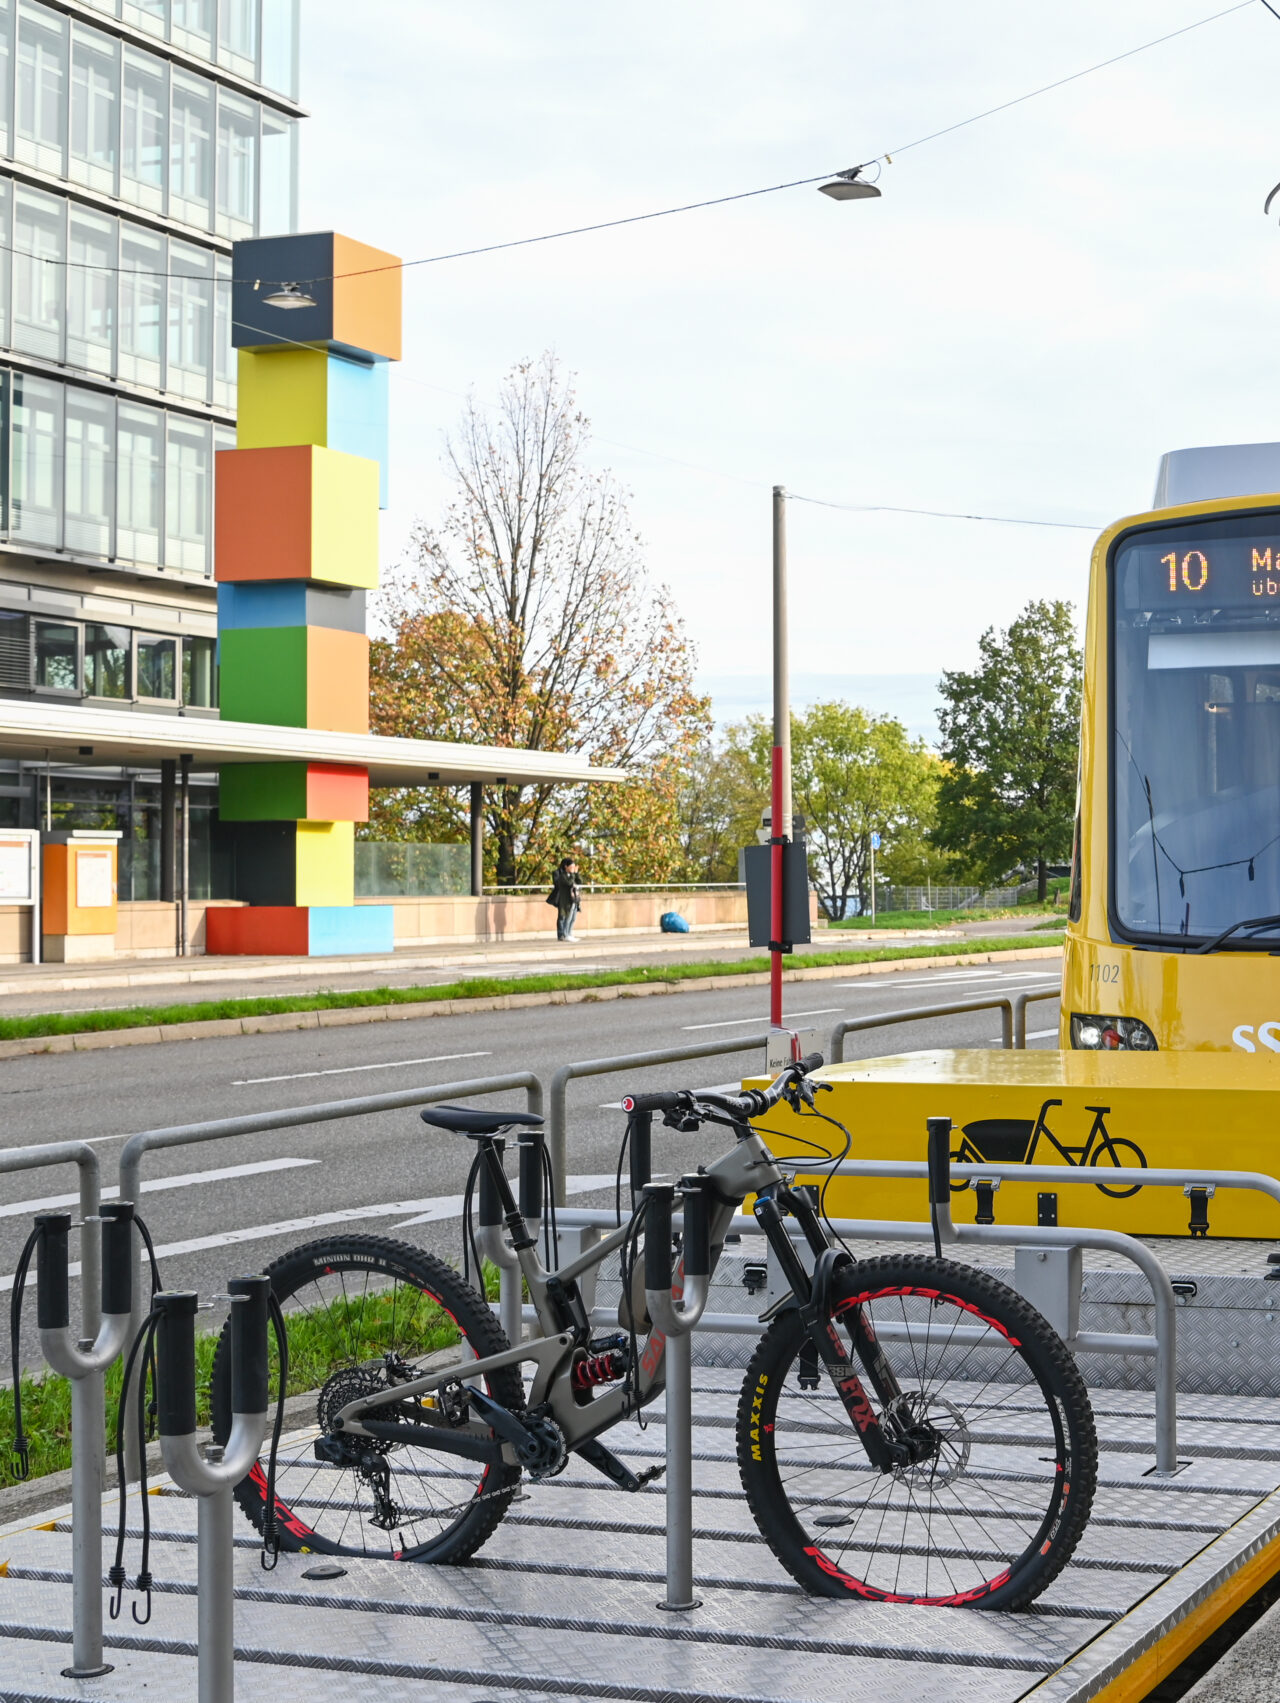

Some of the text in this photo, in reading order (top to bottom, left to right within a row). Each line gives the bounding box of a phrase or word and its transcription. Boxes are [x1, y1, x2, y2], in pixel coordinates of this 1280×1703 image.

[1160, 551, 1208, 591] 10
[1090, 964, 1120, 983] 1102
[770, 1058, 783, 1068] Keine
[313, 1253, 351, 1267] MINION
[353, 1253, 375, 1265] DHR
[829, 1366, 845, 1377] 38
[839, 1375, 879, 1433] FOX
[750, 1373, 769, 1462] MAXXIS
